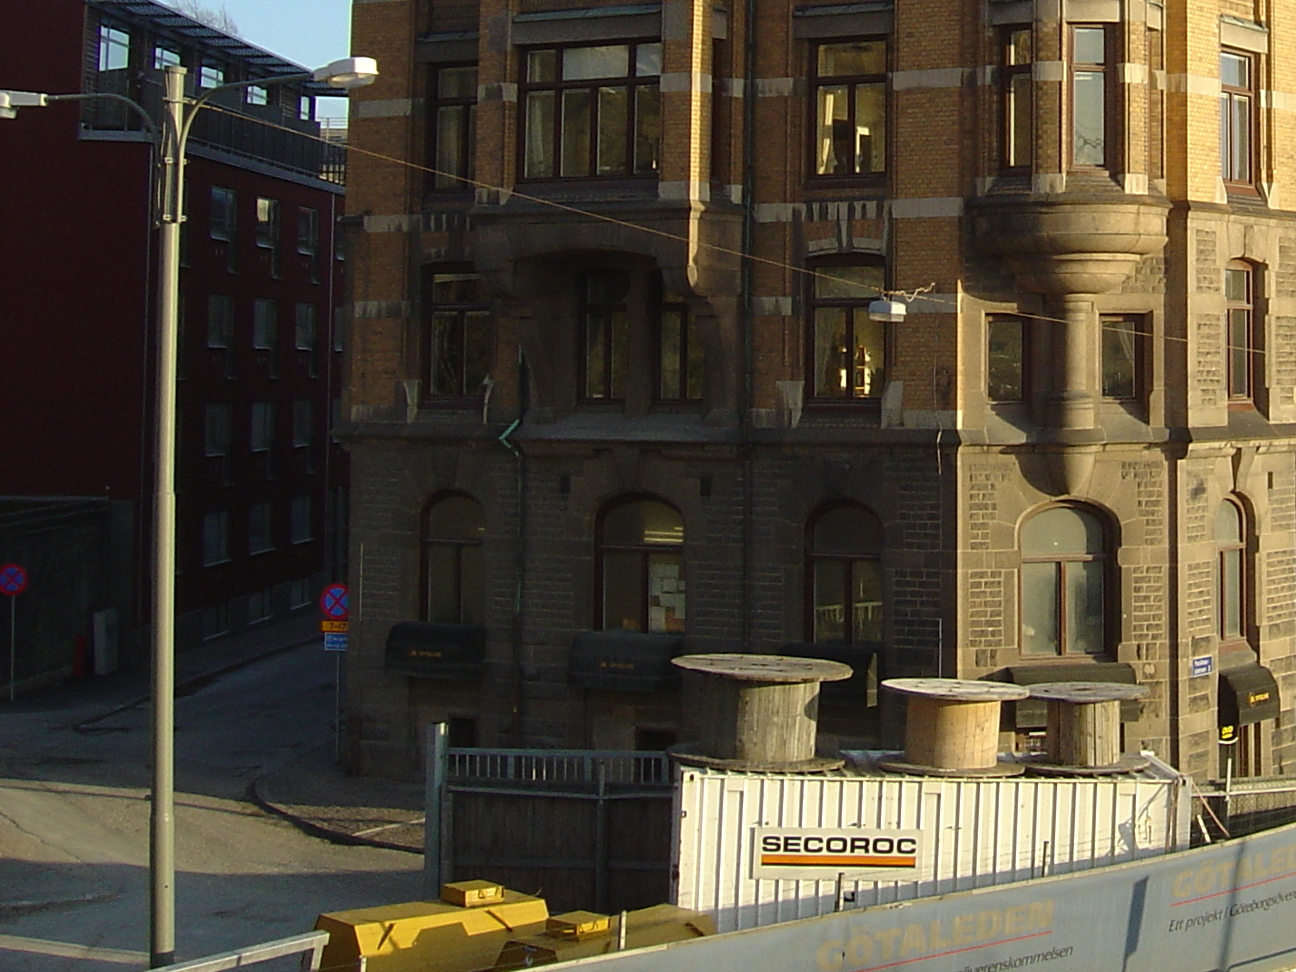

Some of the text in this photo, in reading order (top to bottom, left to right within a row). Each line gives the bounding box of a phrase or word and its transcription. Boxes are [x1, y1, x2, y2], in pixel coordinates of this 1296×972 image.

[762, 836, 917, 855] SECOROC
[1168, 918, 1182, 933] Ett
[1184, 909, 1223, 932] projekt
[816, 899, 1056, 971] GÖTALEDEN
